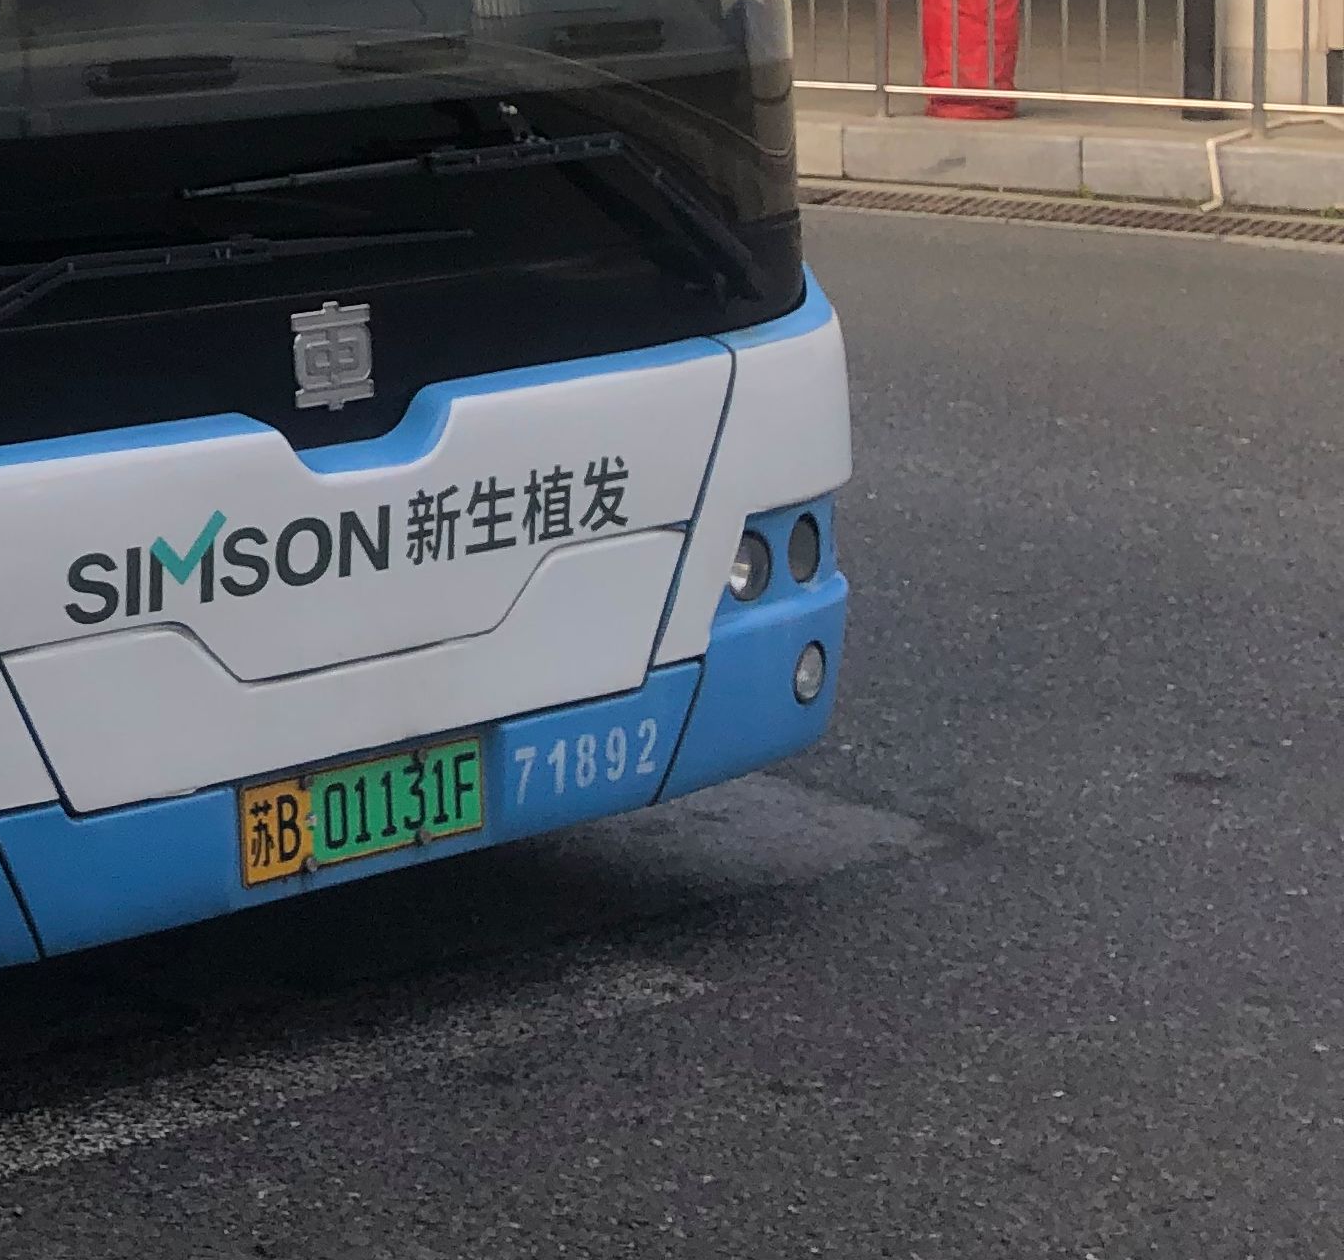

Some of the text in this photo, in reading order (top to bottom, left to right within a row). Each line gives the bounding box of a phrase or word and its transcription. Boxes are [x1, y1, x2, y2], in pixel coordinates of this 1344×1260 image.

[64, 455, 630, 626] SIMSON 新生植发
[514, 717, 659, 805] 71892
